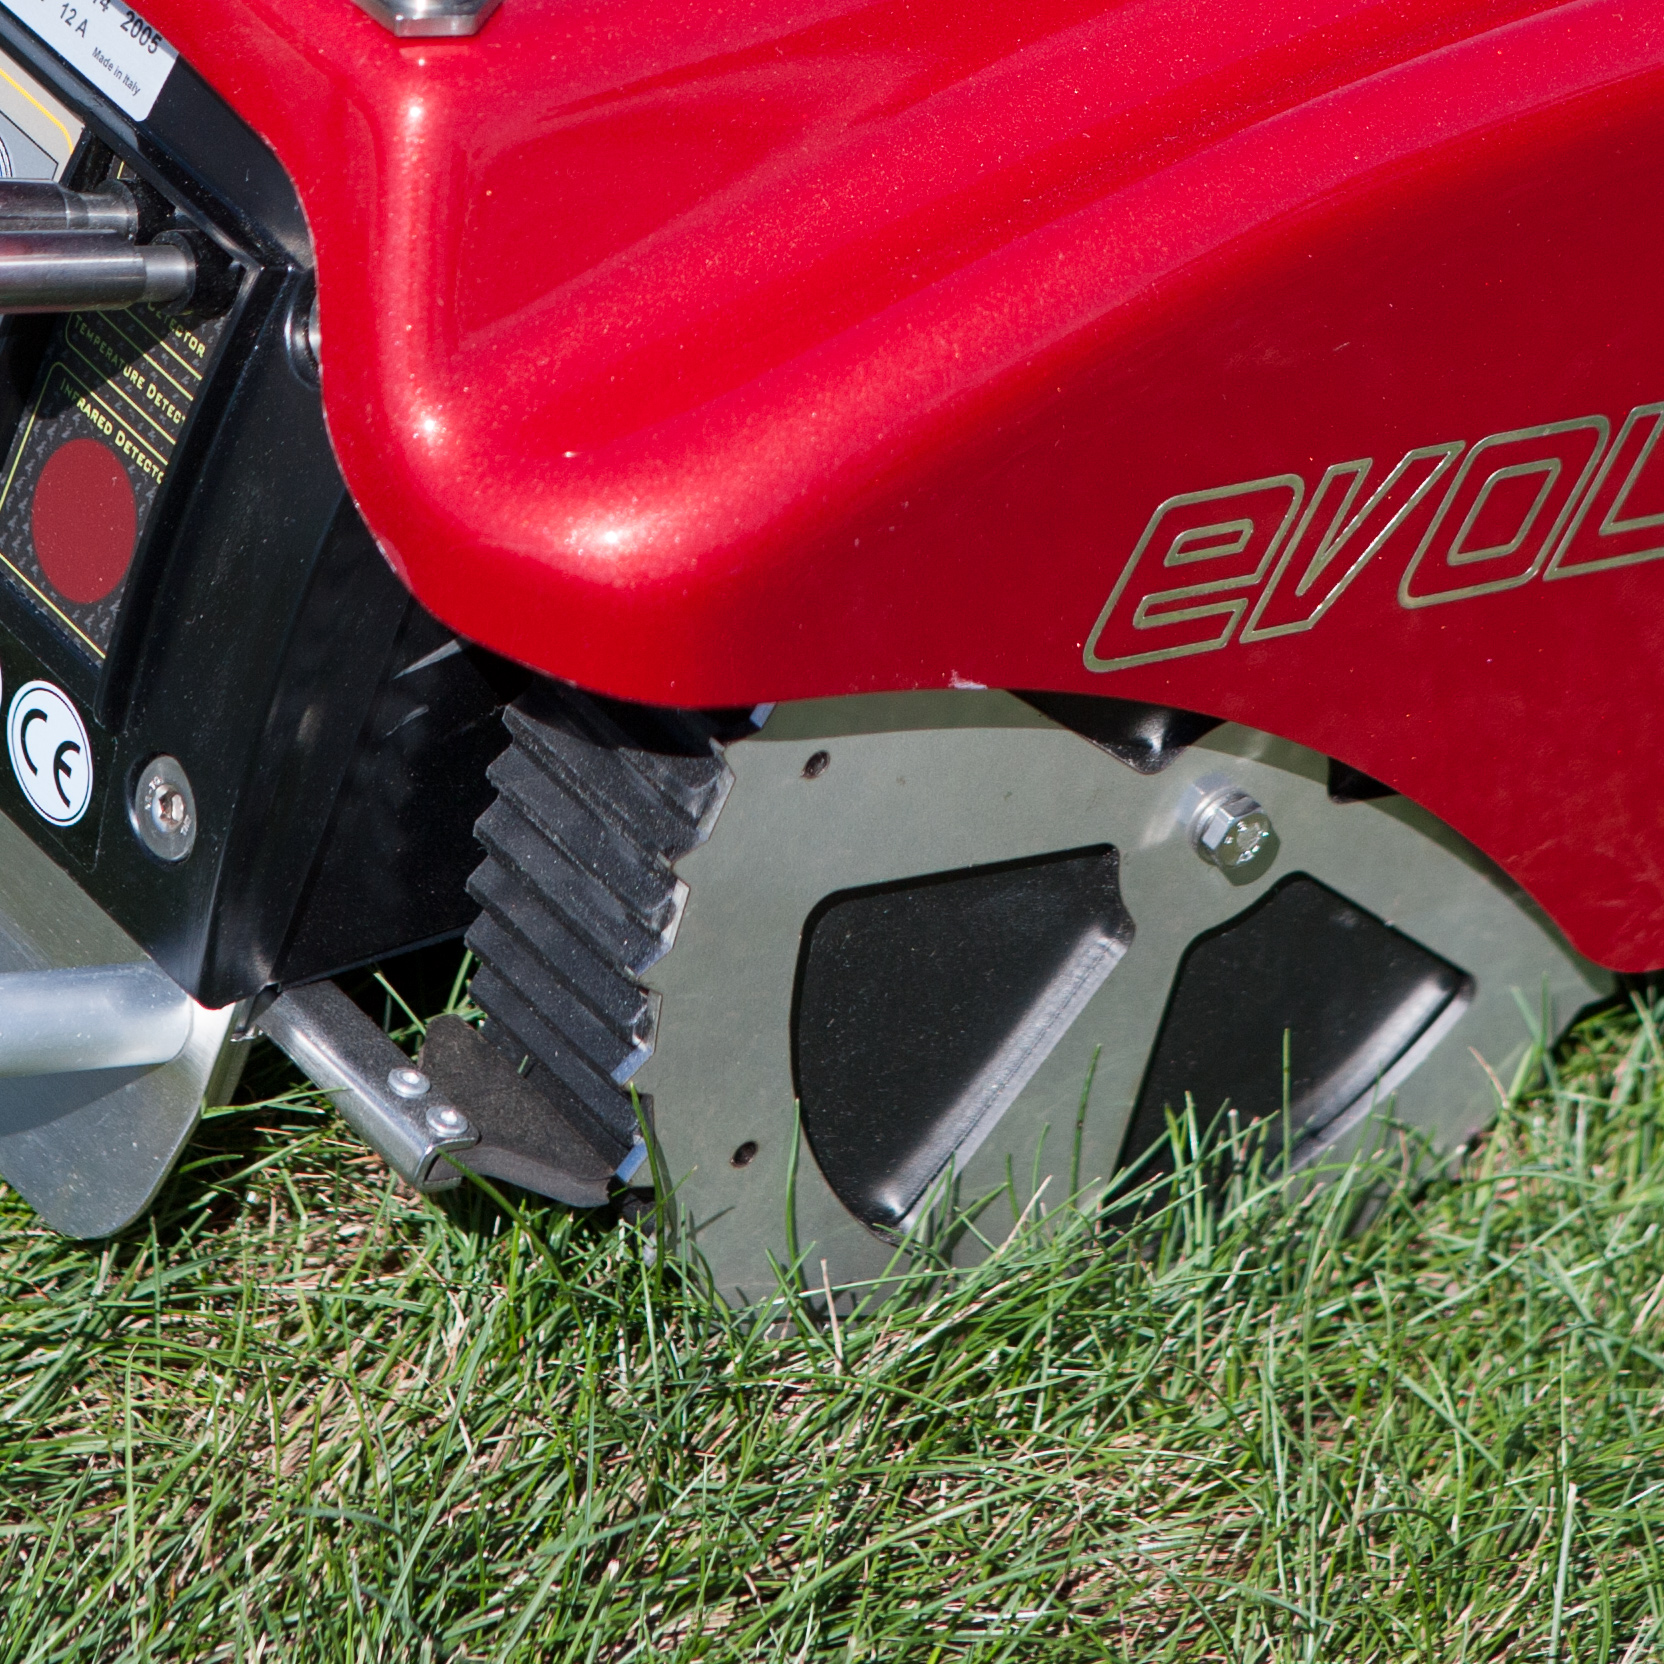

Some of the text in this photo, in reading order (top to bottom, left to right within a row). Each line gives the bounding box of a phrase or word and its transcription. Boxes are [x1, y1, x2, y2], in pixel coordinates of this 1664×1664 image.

[59, 2, 78, 27] 12
[120, 10, 163, 55] 2005
[92, 46, 141, 97] Made in Italy
[60, 378, 113, 435] INFRARED
[20, 707, 81, 809] CE
